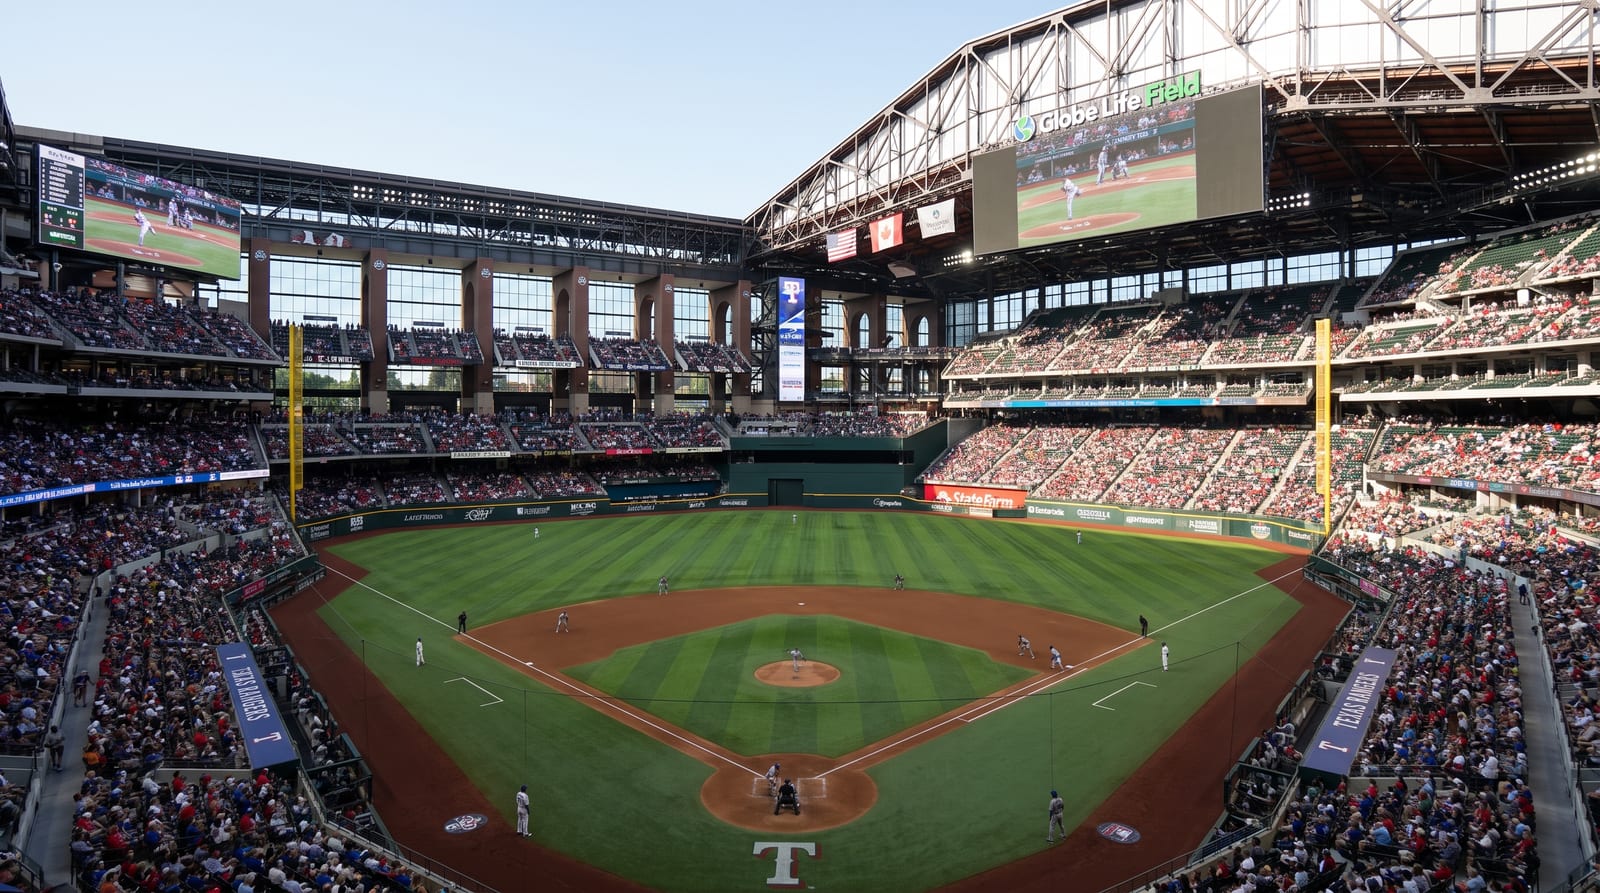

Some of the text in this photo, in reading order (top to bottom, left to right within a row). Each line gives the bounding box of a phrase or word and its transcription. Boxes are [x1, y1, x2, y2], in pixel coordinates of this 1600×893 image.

[1039, 69, 1201, 133] Globe Life Field
[953, 491, 1013, 509] State Farm
[231, 666, 271, 722] TEXAS RANGERS
[1333, 672, 1380, 729] TEXAS RANGERS
[752, 841, 819, 887] T
